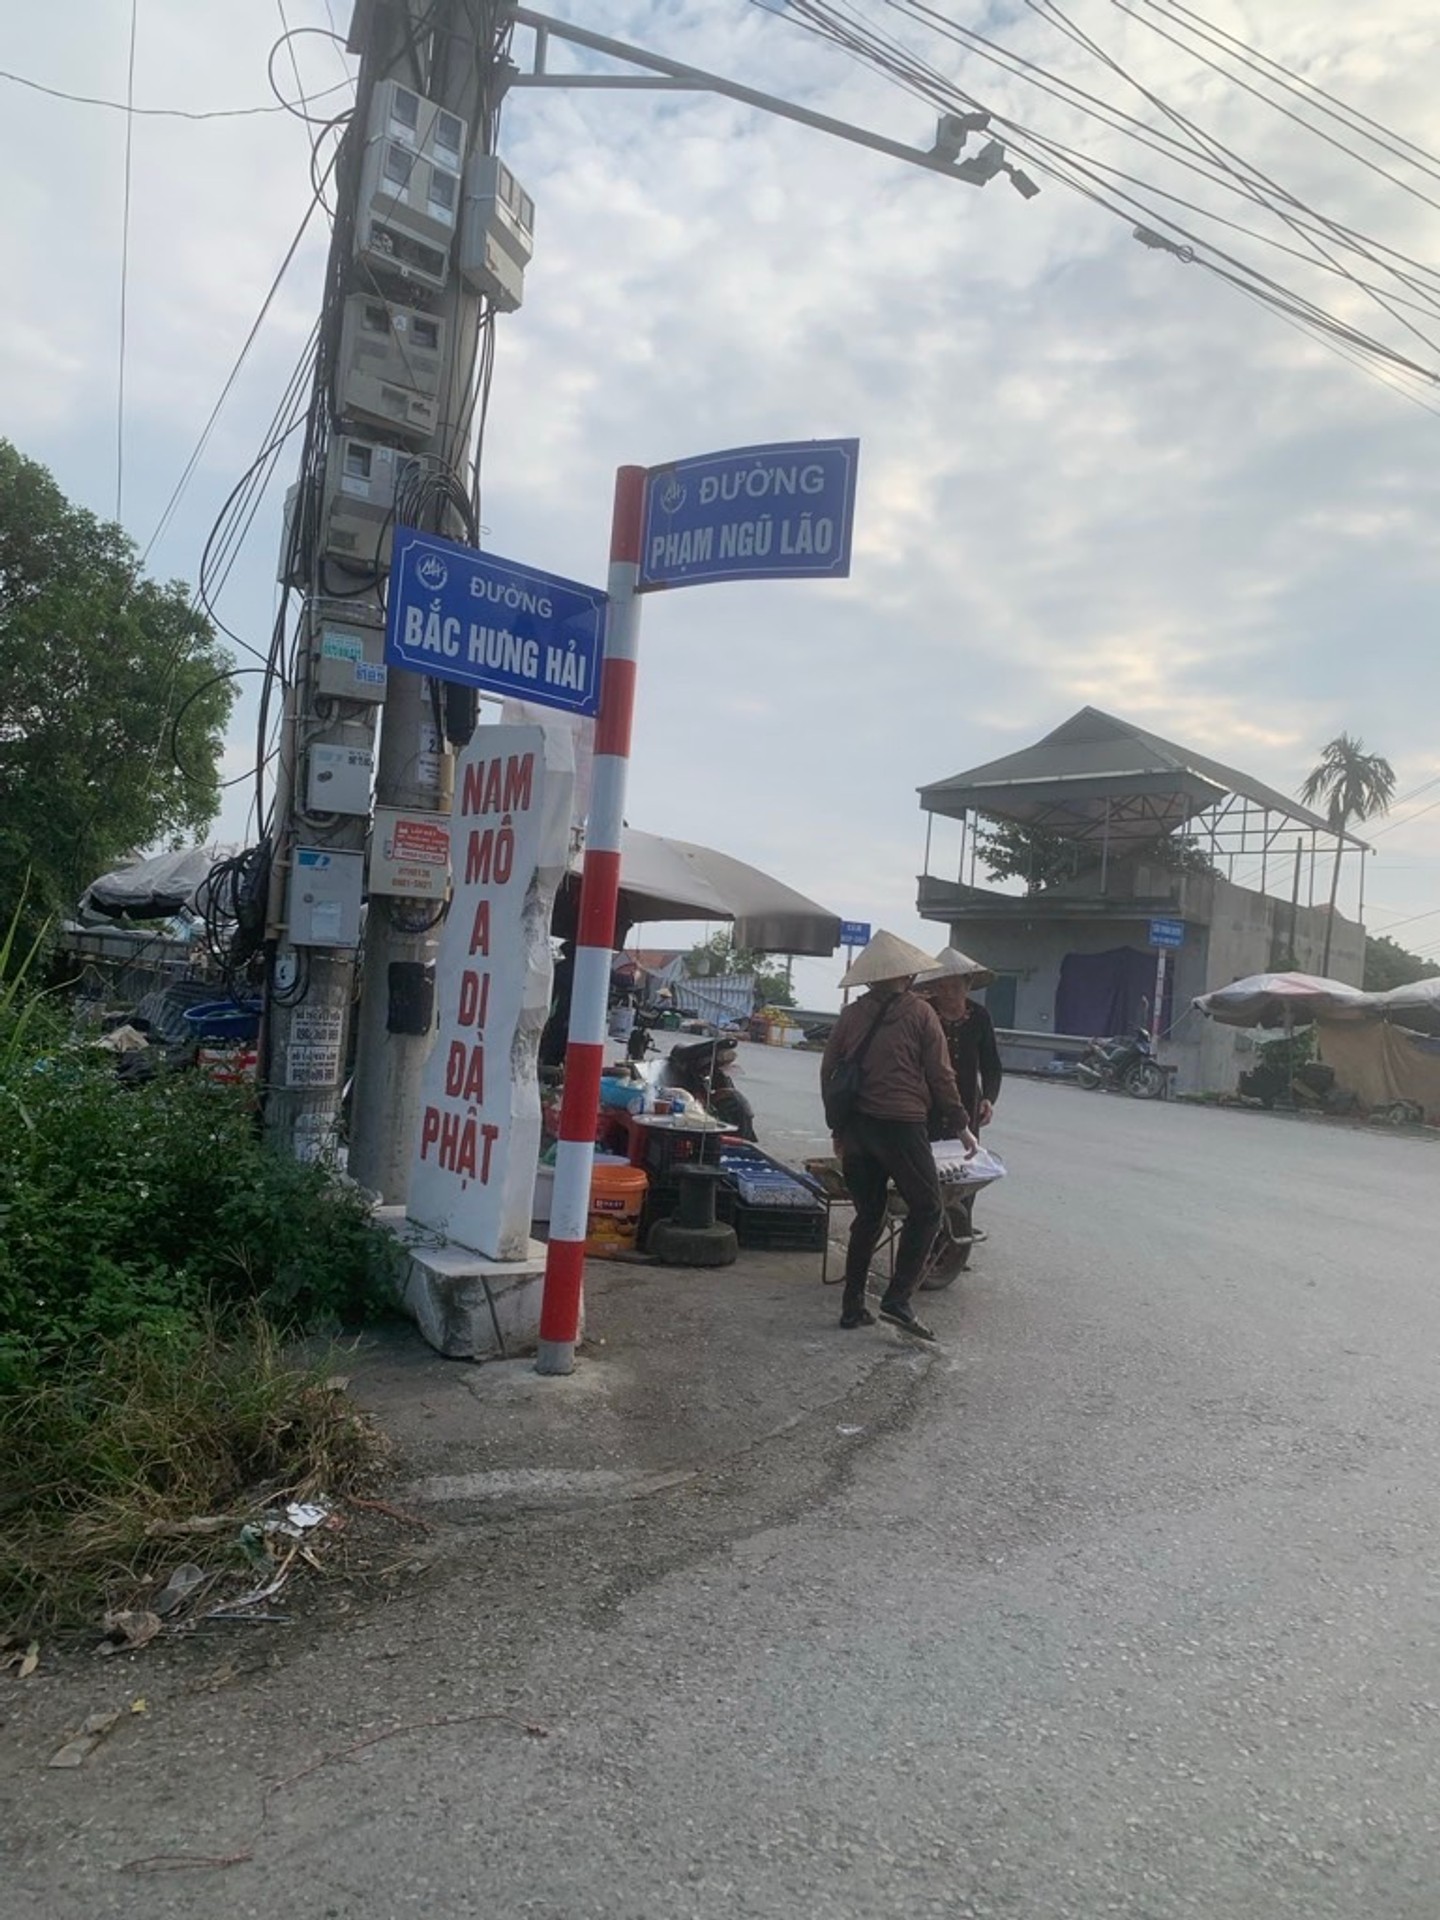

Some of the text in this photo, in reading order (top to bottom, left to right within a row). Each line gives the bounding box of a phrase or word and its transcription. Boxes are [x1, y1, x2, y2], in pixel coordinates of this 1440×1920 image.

[700, 461, 825, 504] ĐƯỜNG
[651, 511, 833, 571] PHẠM NGŨ LÃO
[470, 575, 553, 618] ĐƯỜNG
[404, 598, 461, 658] BẮC
[468, 624, 540, 679] HƯNG
[545, 639, 586, 691] HẢI
[461, 753, 534, 816] NAM
[465, 814, 514, 885] MÔ
[469, 900, 490, 957] A
[457, 969, 490, 1029] DI
[445, 1031, 485, 1106] ĐÀ
[420, 1105, 499, 1190] PHẬT
